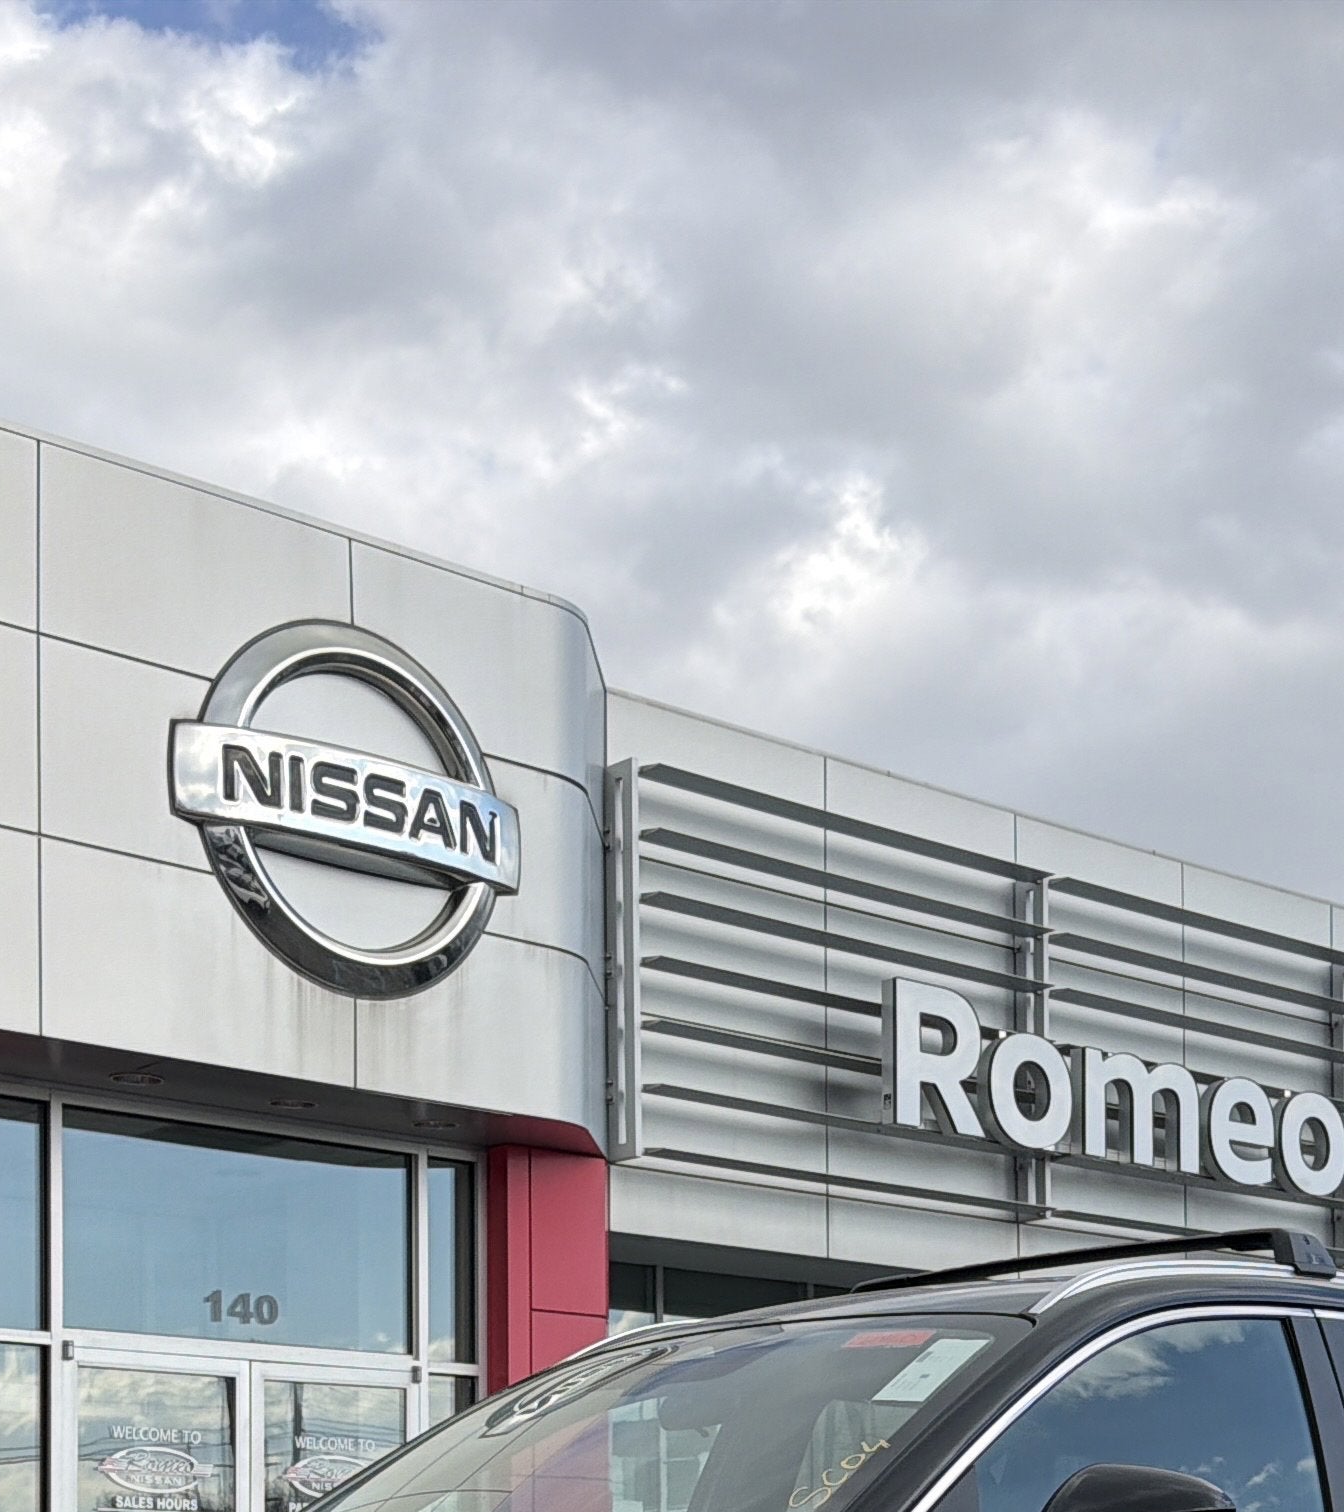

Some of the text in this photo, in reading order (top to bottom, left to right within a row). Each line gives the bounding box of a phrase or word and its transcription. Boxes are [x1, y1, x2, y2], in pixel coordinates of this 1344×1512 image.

[222, 743, 501, 866] NISSAN
[203, 1290, 279, 1325] 140
[112, 1425, 202, 1444] WELCOME TO
[295, 1436, 376, 1452] WELCOME TO
[129, 1474, 184, 1487] NISSAN
[311, 1481, 338, 1493] NIS
[116, 1495, 198, 1511] SALES HOURS
